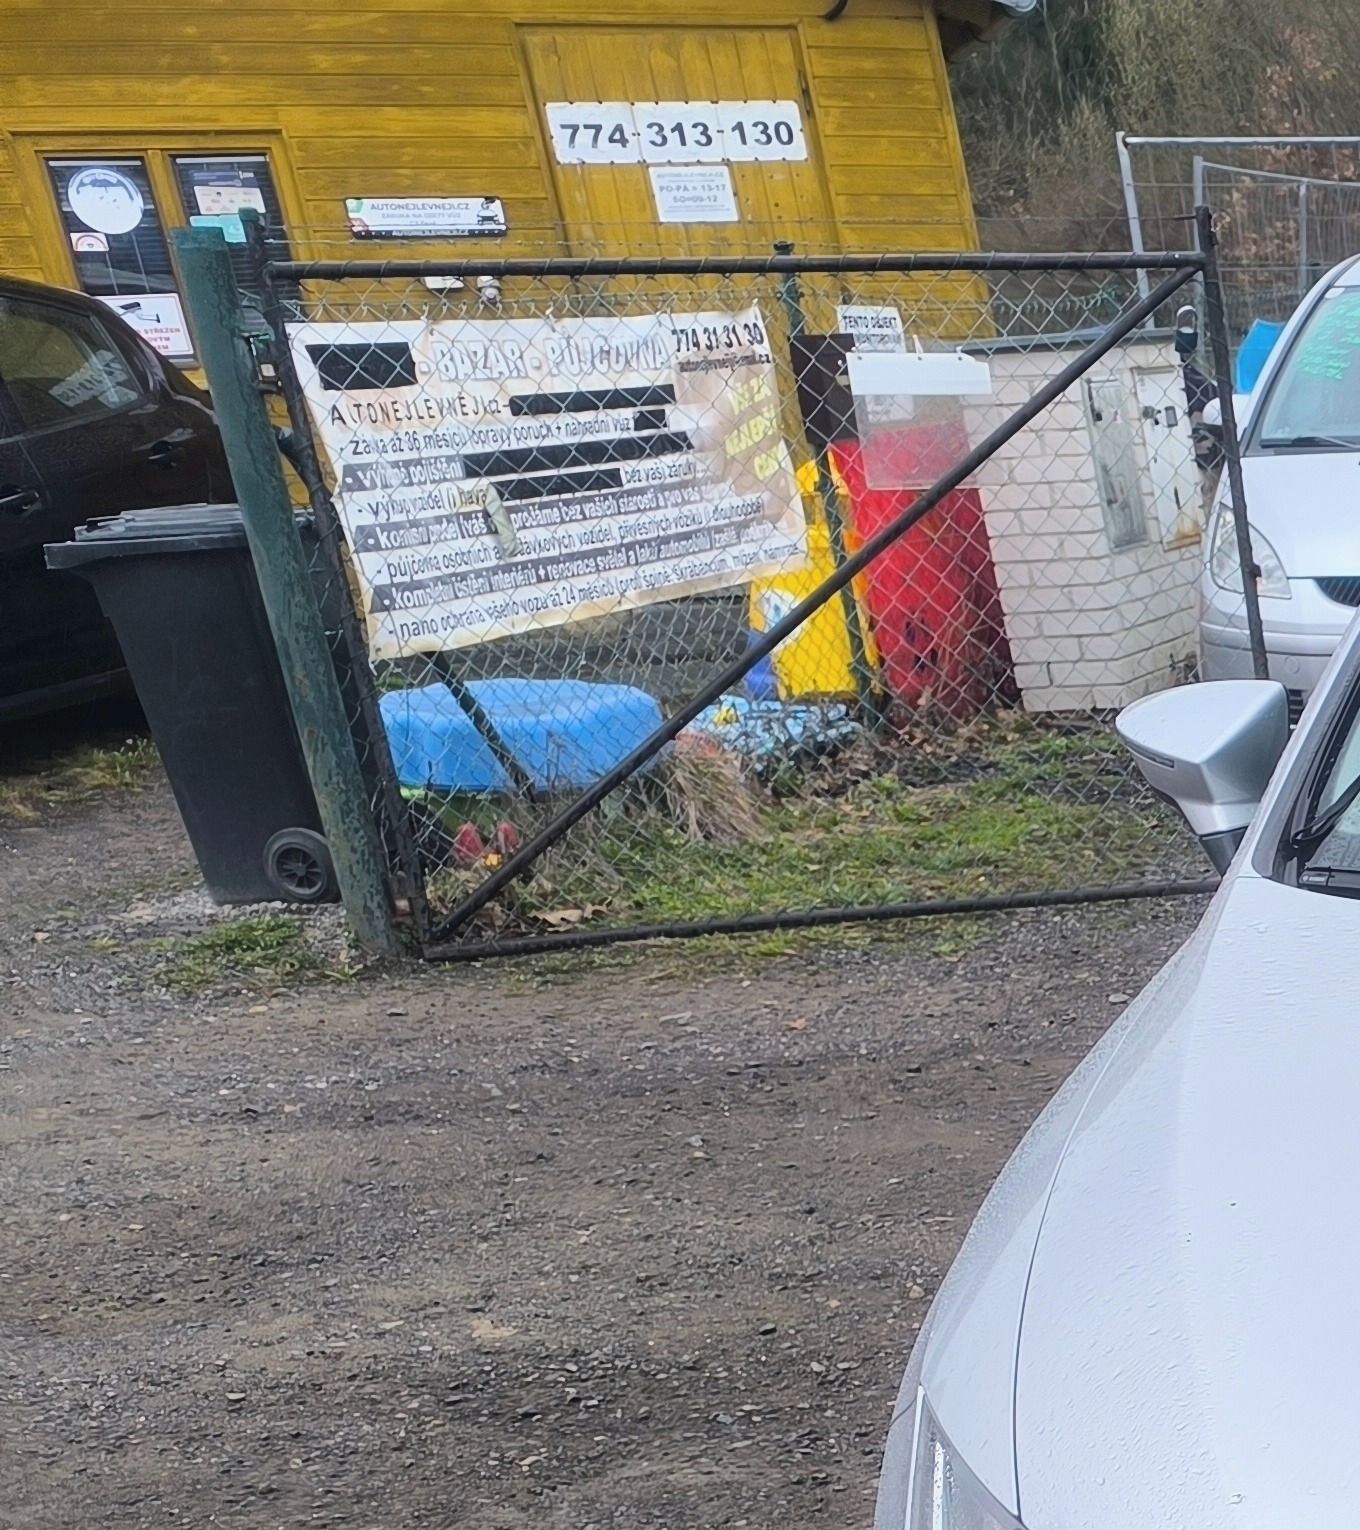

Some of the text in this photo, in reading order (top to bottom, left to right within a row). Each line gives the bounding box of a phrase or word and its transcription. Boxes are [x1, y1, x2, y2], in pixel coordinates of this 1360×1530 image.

[671, 322, 765, 352] 774 31 31 30
[431, 340, 527, 381] BAZAR
[406, 431, 420, 451] 36
[400, 618, 438, 639] nano
